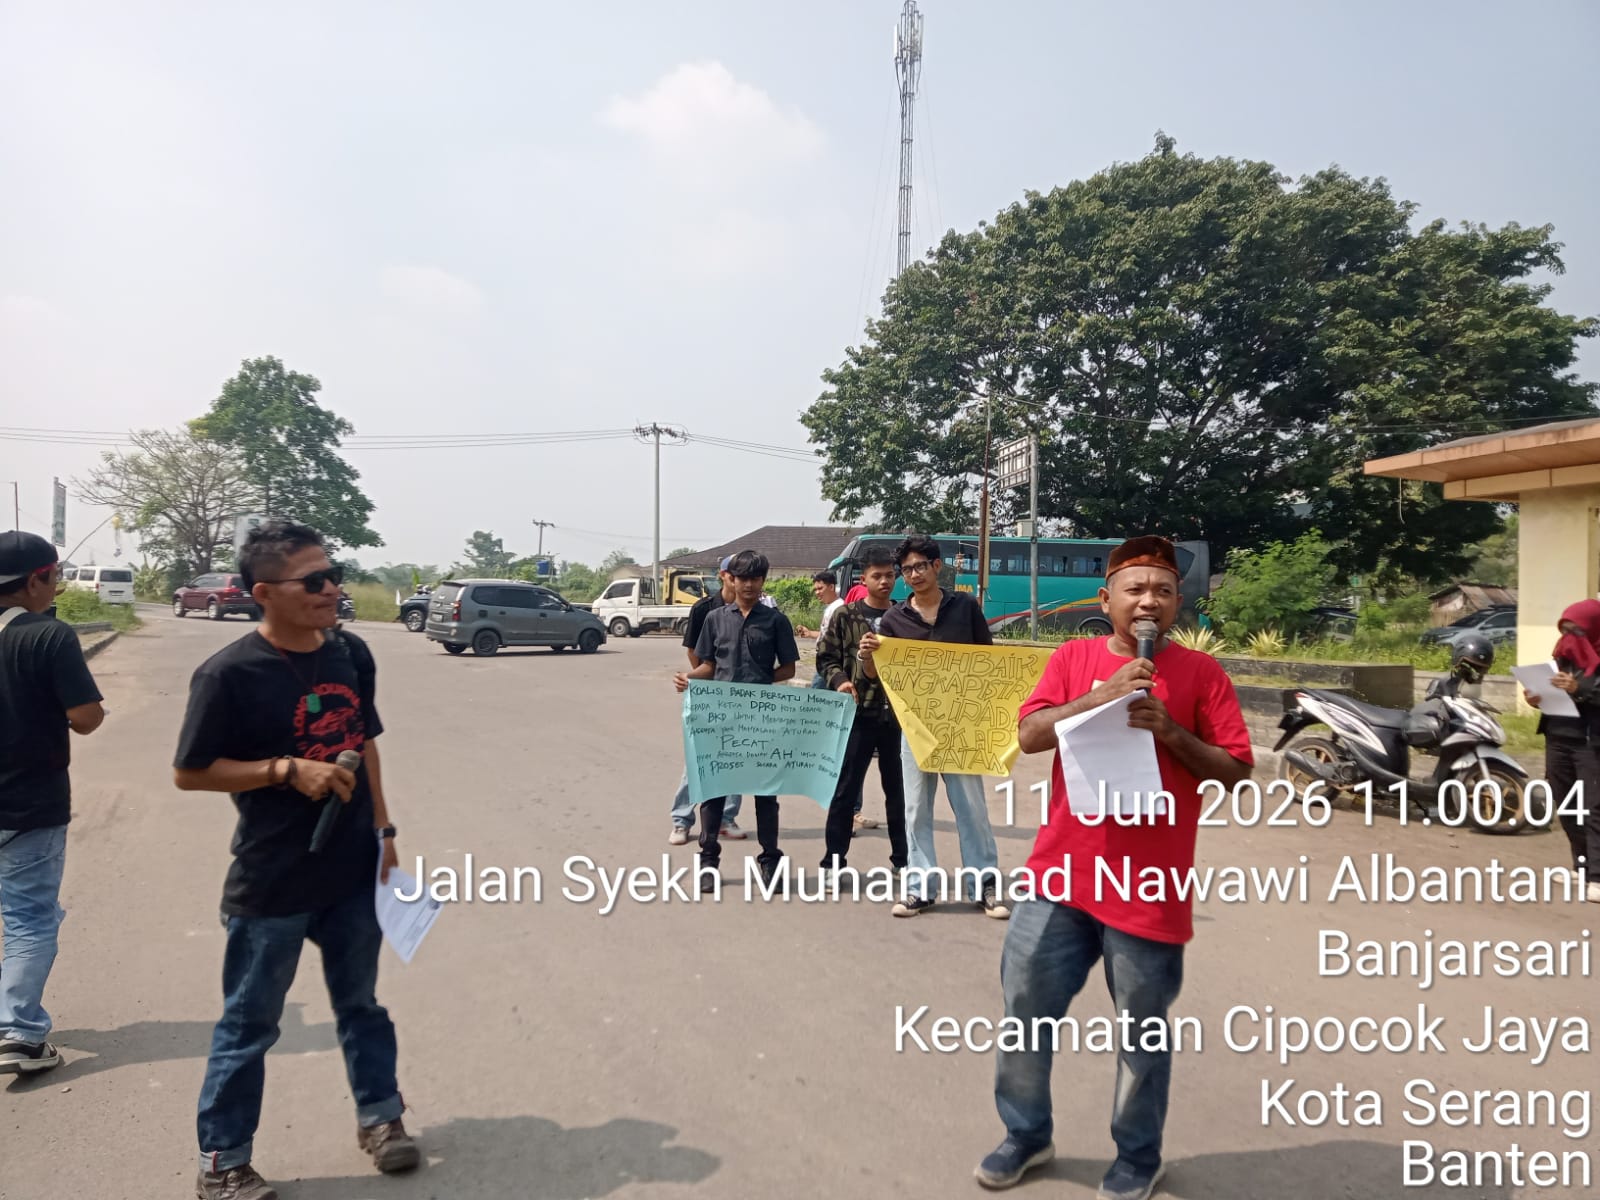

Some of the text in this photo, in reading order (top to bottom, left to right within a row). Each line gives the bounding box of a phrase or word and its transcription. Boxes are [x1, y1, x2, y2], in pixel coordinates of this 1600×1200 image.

[689, 684, 723, 698] KOALISI
[730, 687, 756, 698] BADAK
[760, 689, 801, 702] BERSATU
[750, 700, 776, 712] DPRD
[708, 711, 728, 723] BKD
[902, 697, 1019, 732] ARIPAD
[710, 760, 745, 776] PROSES
